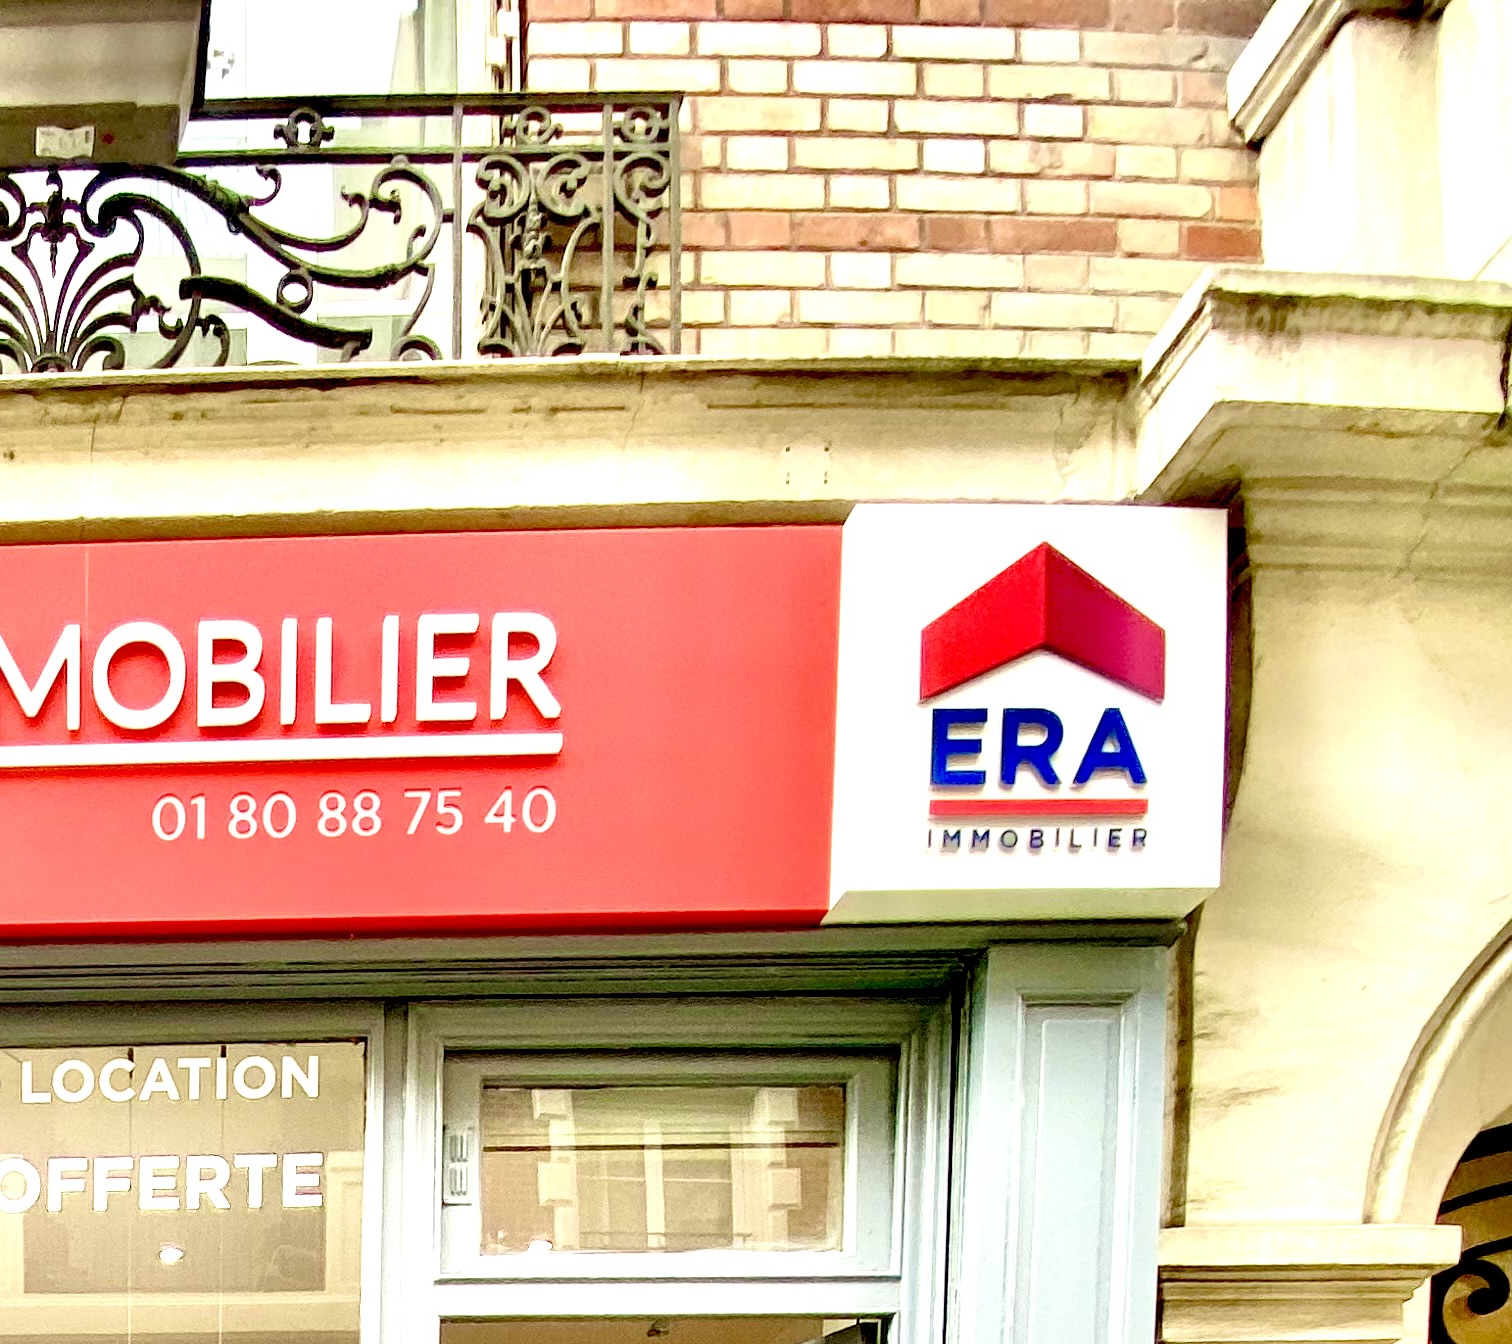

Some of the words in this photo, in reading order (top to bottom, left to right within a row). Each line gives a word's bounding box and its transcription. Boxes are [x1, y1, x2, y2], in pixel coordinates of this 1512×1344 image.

[930, 707, 1148, 786] ERA
[151, 794, 207, 841] 01
[227, 792, 297, 839] 80
[317, 789, 382, 838] 88
[403, 786, 464, 836] 75
[484, 785, 557, 834] 40
[927, 826, 1148, 850] IMMOBILIER
[21, 1055, 319, 1104] LOCATION
